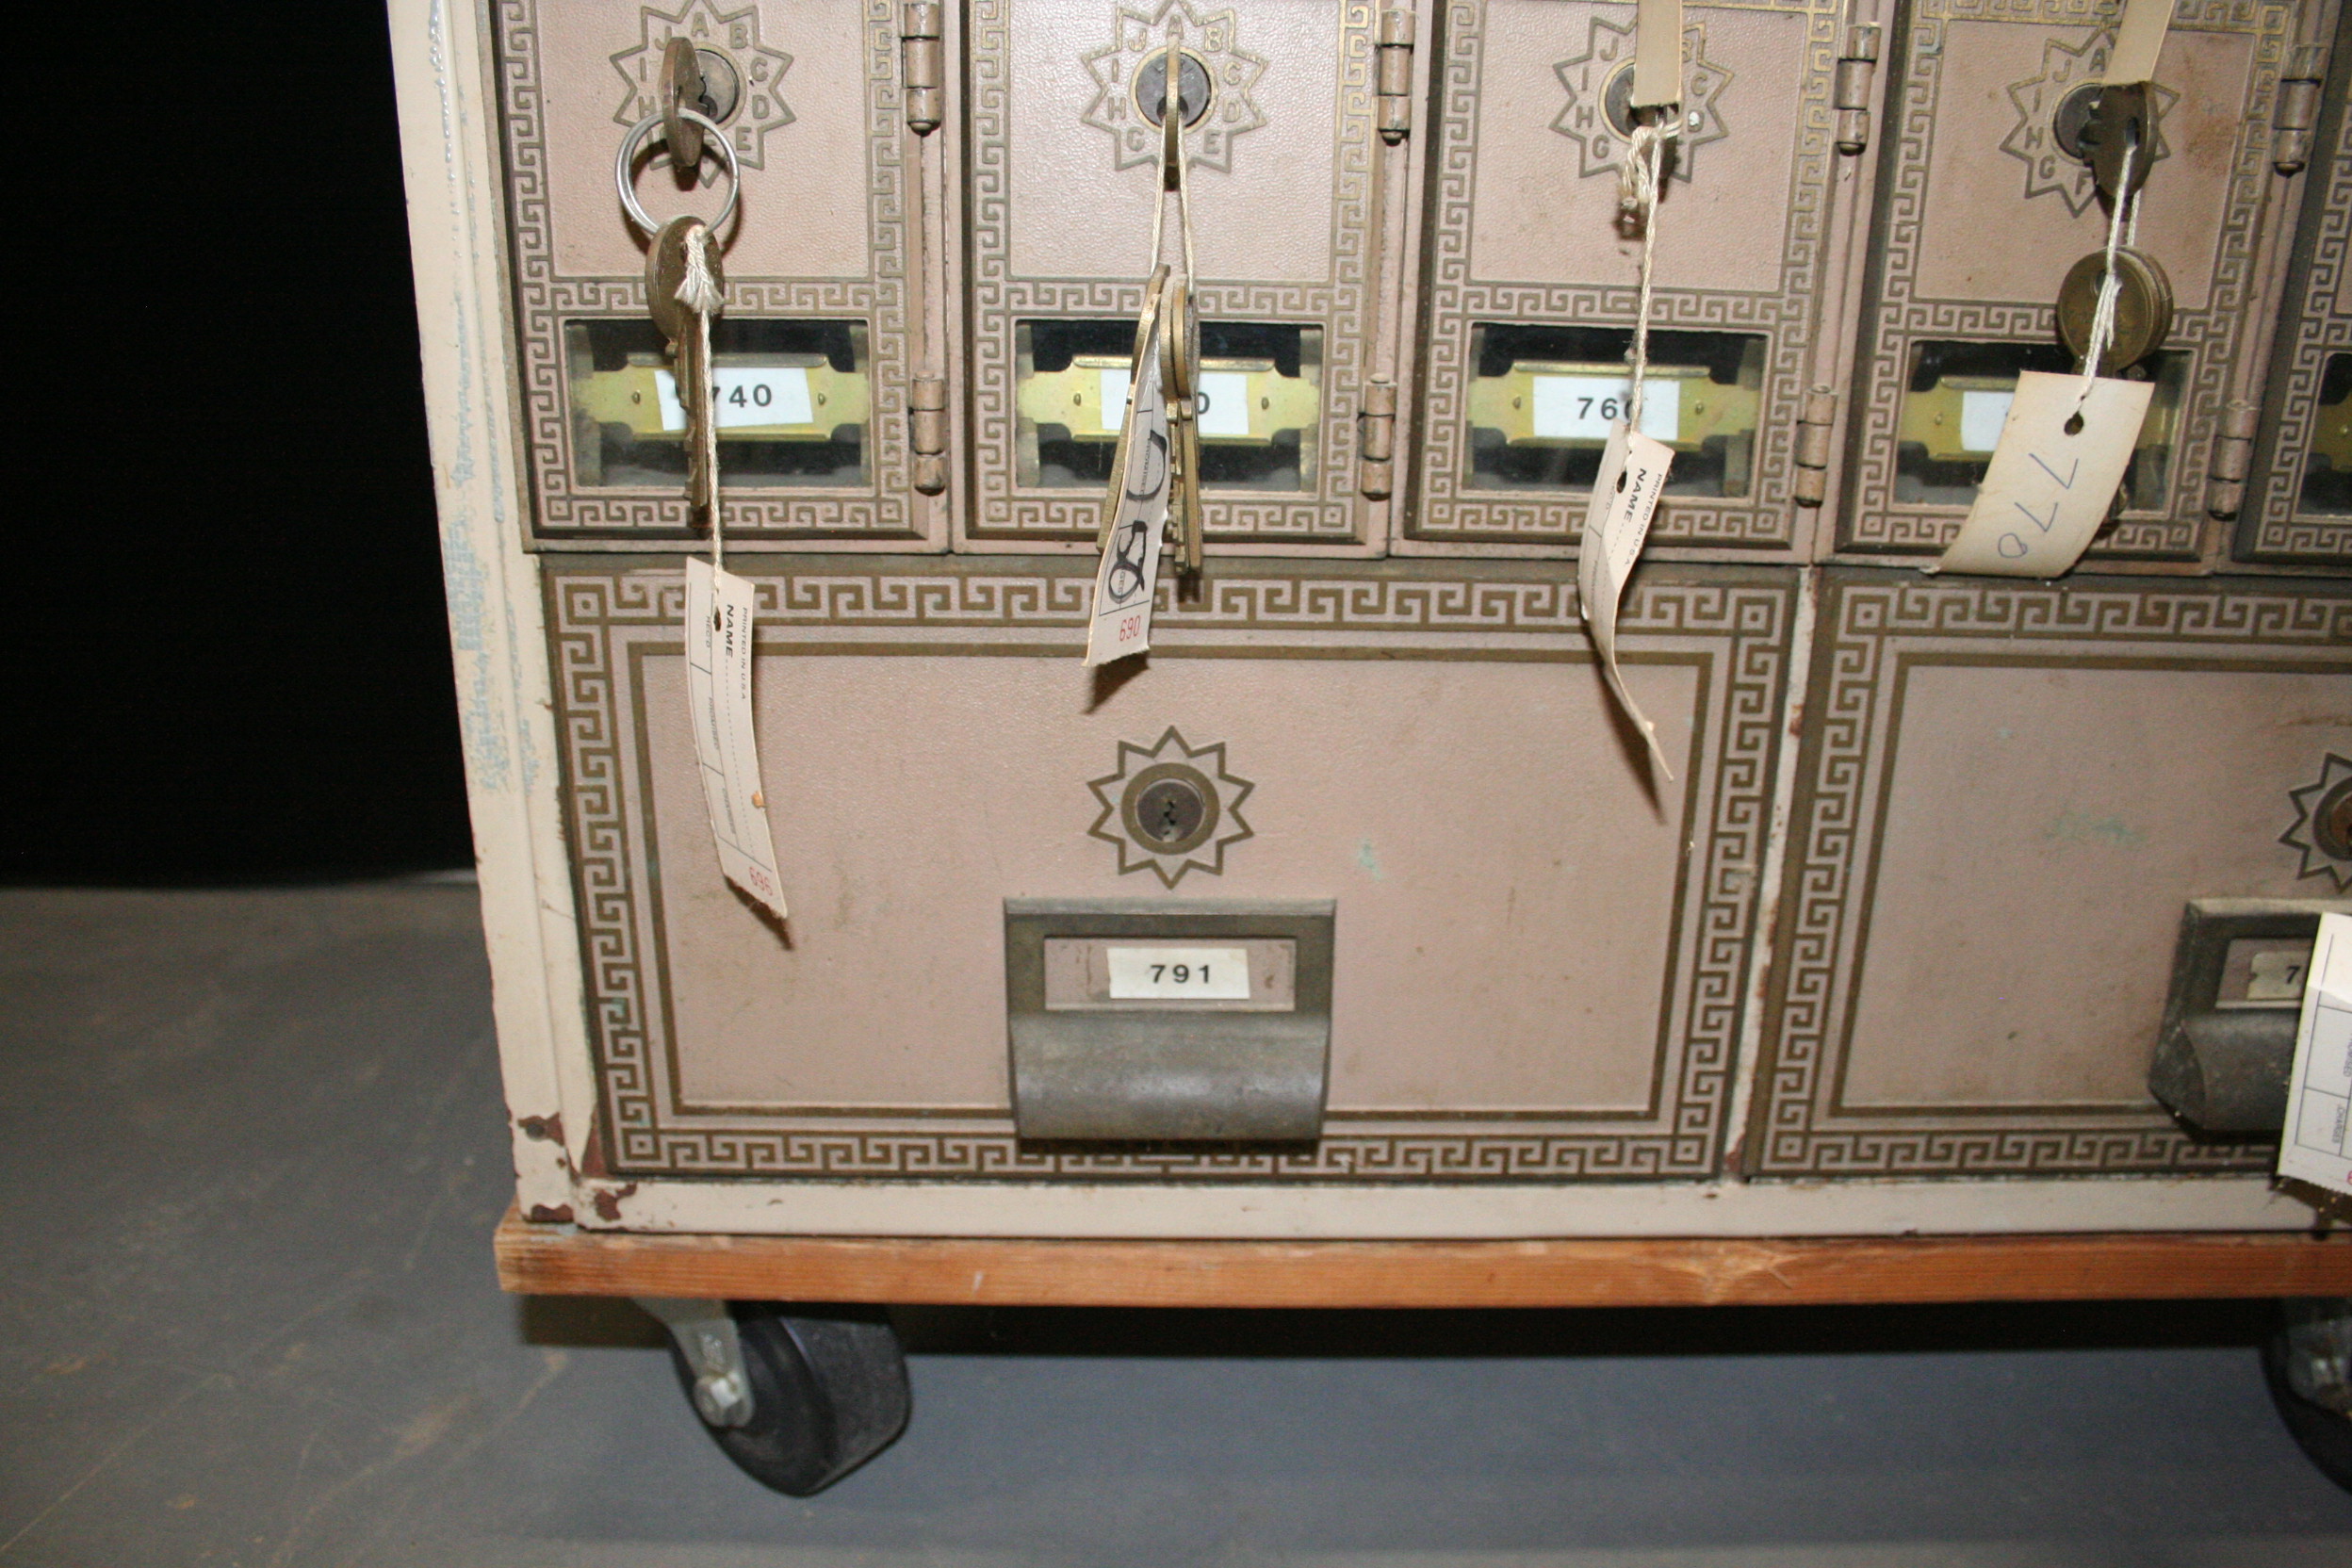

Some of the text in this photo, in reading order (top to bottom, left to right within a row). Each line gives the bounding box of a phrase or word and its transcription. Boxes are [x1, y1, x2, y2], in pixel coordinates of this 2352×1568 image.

[1623, 467, 1647, 523] NAME
[1642, 473, 1663, 521] PRINTED
[1998, 452, 2079, 559] 770
[1638, 524, 1646, 535] IN
[726, 604, 735, 658] NAME
[1151, 964, 1209, 984] 791
